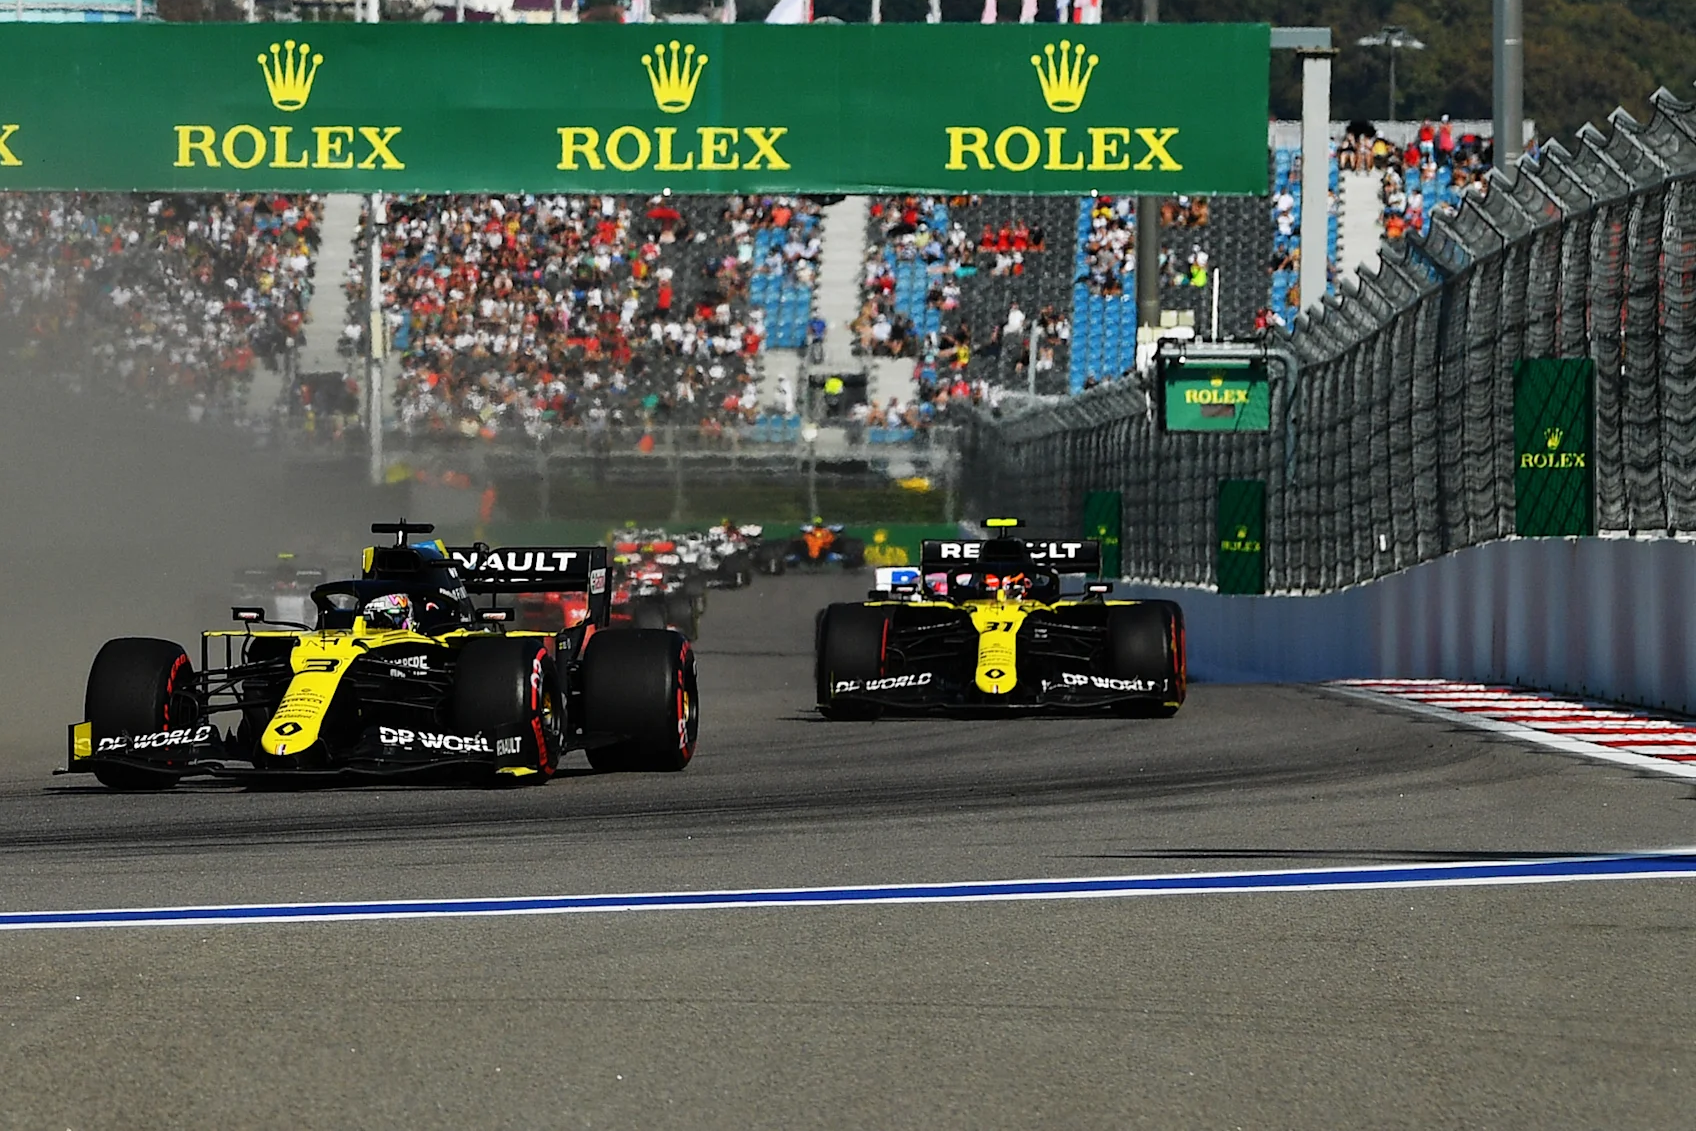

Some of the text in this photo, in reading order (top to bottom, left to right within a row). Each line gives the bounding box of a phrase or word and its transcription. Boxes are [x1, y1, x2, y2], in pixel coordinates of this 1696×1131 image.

[174, 125, 404, 169] ROLEX
[557, 126, 791, 171] ROLEX
[945, 126, 1183, 171] ROLEX
[1184, 389, 1250, 404] ROLEX
[1520, 453, 1586, 468] ROLEX
[452, 552, 577, 572] NAULT
[301, 658, 343, 674] 3
[866, 673, 932, 691] WORLD
[1062, 673, 1089, 685] DP
[133, 726, 212, 749] WORLD
[379, 726, 494, 753] DP WORL
